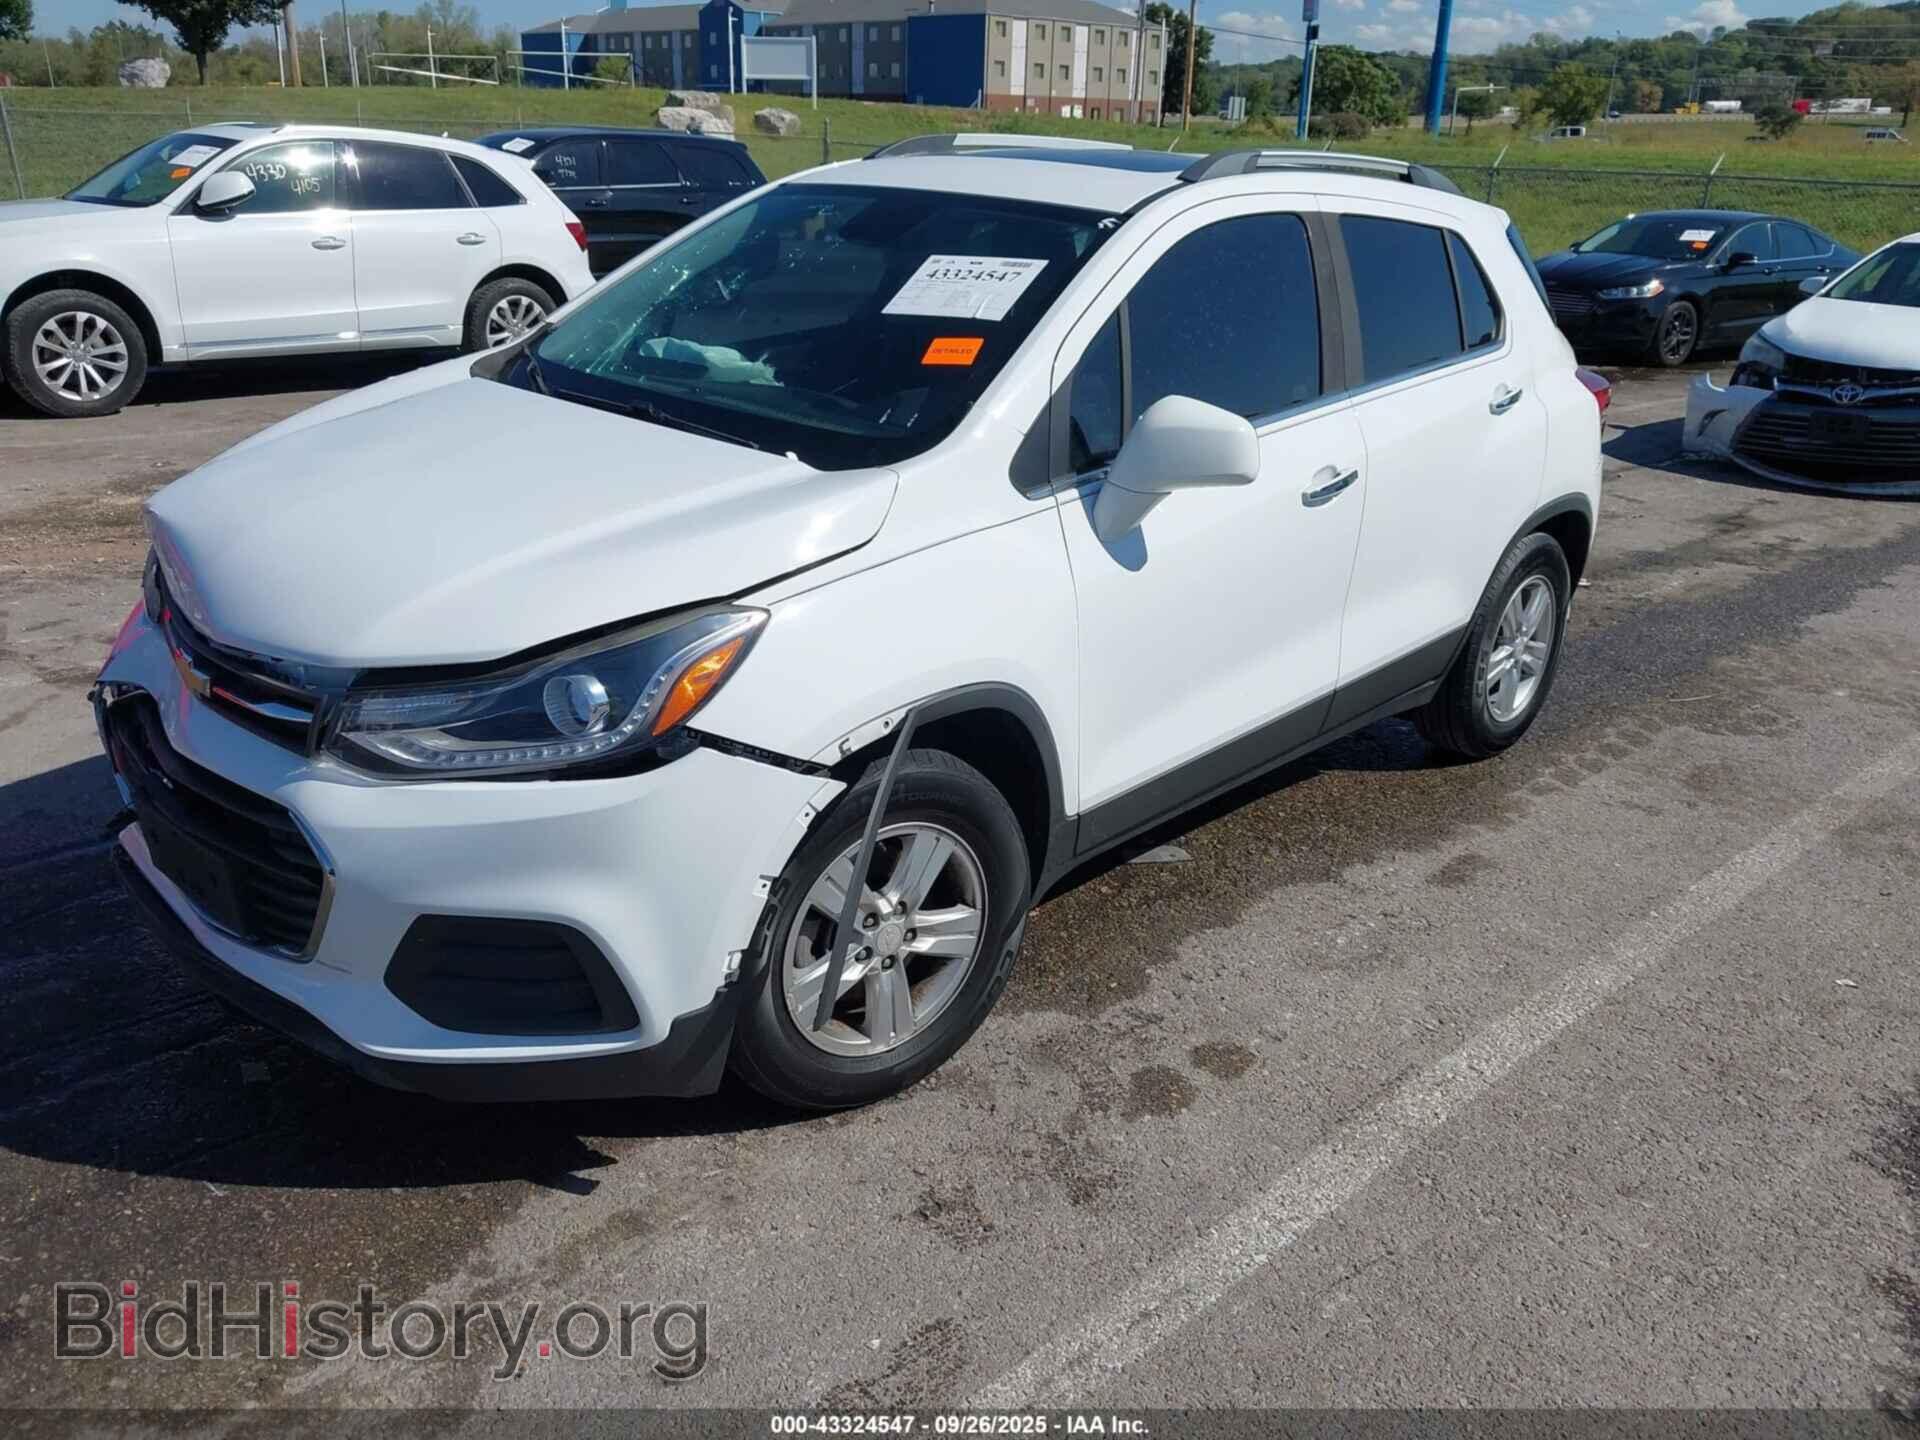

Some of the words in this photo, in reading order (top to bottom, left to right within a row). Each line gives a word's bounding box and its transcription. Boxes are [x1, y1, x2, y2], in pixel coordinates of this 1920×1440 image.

[291, 177, 321, 197] 4105
[926, 268, 1022, 283] 43324547
[931, 347, 974, 355] DETAILED
